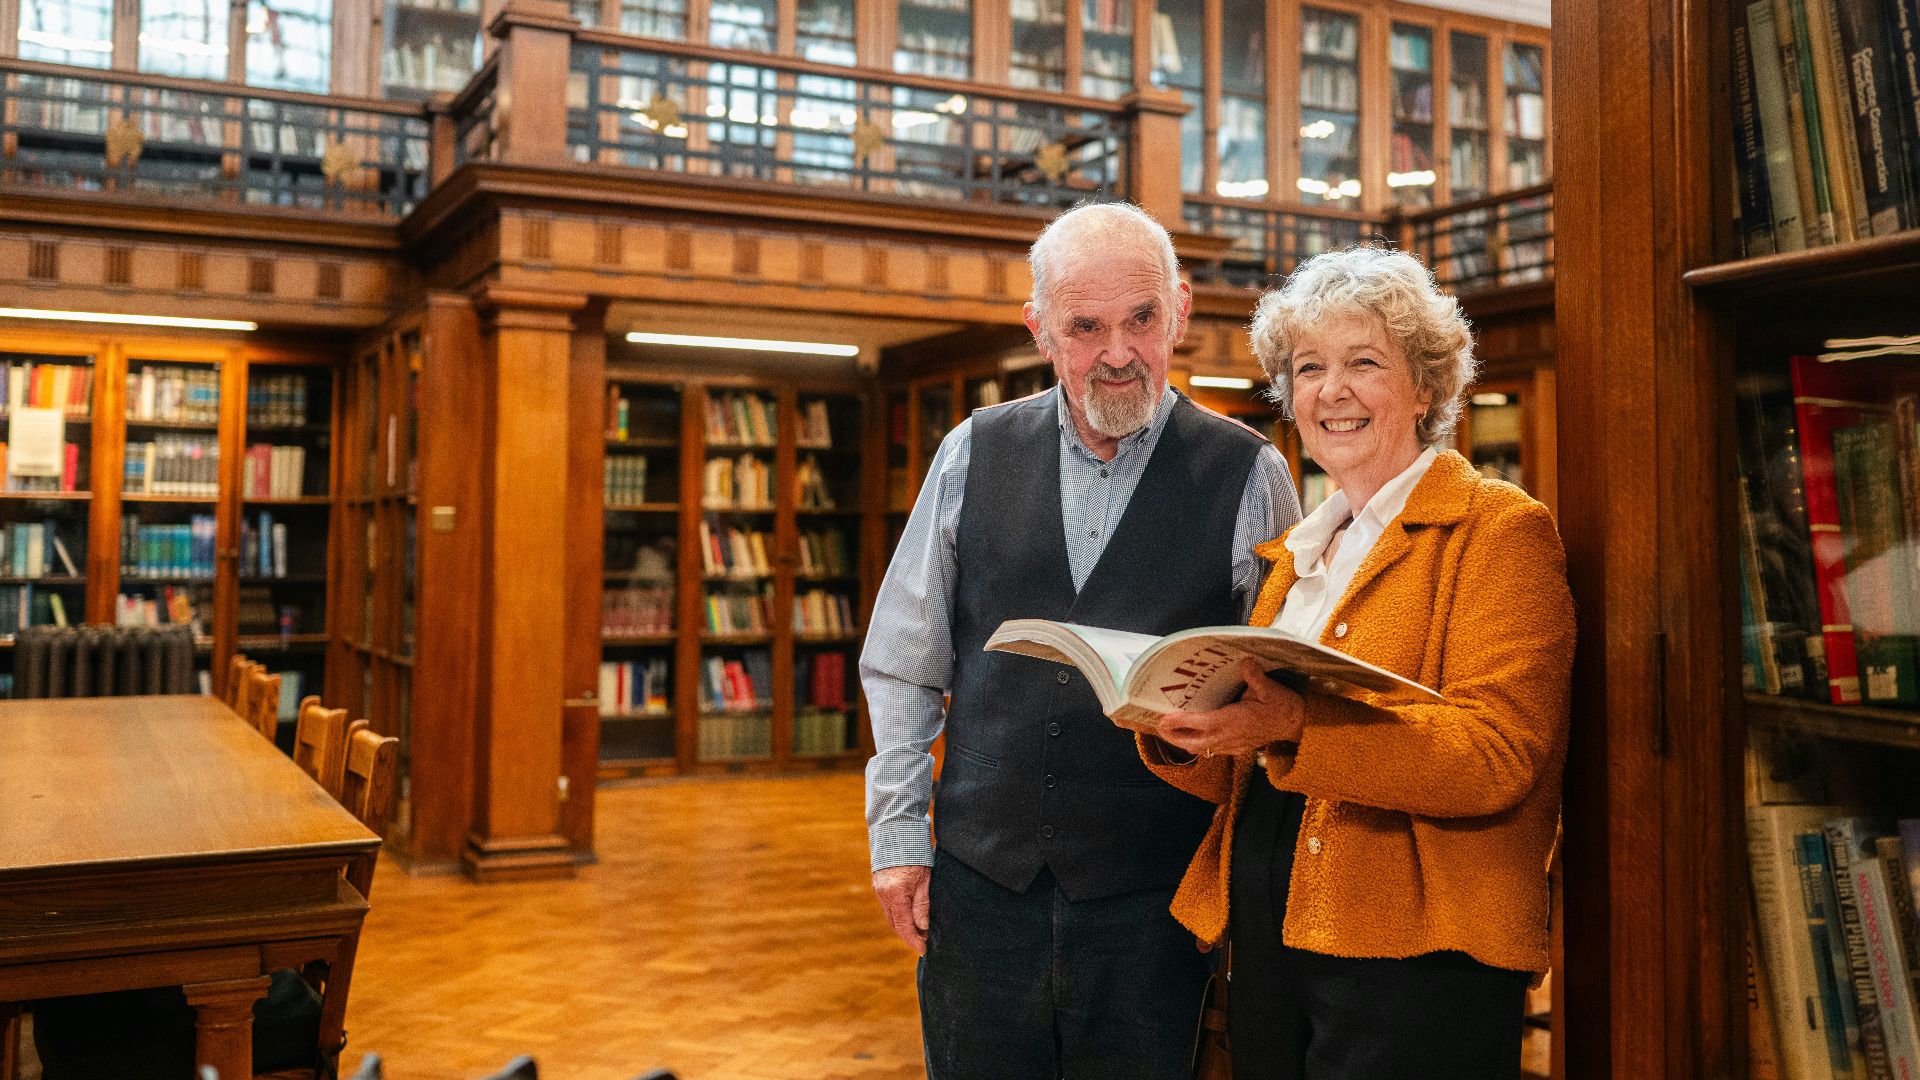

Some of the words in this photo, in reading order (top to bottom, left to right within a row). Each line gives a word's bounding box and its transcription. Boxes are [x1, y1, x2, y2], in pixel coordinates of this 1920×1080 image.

[1852, 52, 1868, 116] Handbook
[1860, 48, 1877, 110] Concrete
[1869, 107, 1889, 193] Construction
[1160, 645, 1228, 706] ART
[1178, 656, 1239, 709] SCHOOL
[1836, 868, 1856, 905] FURY
[1845, 922, 1877, 1005] PHANTOM
